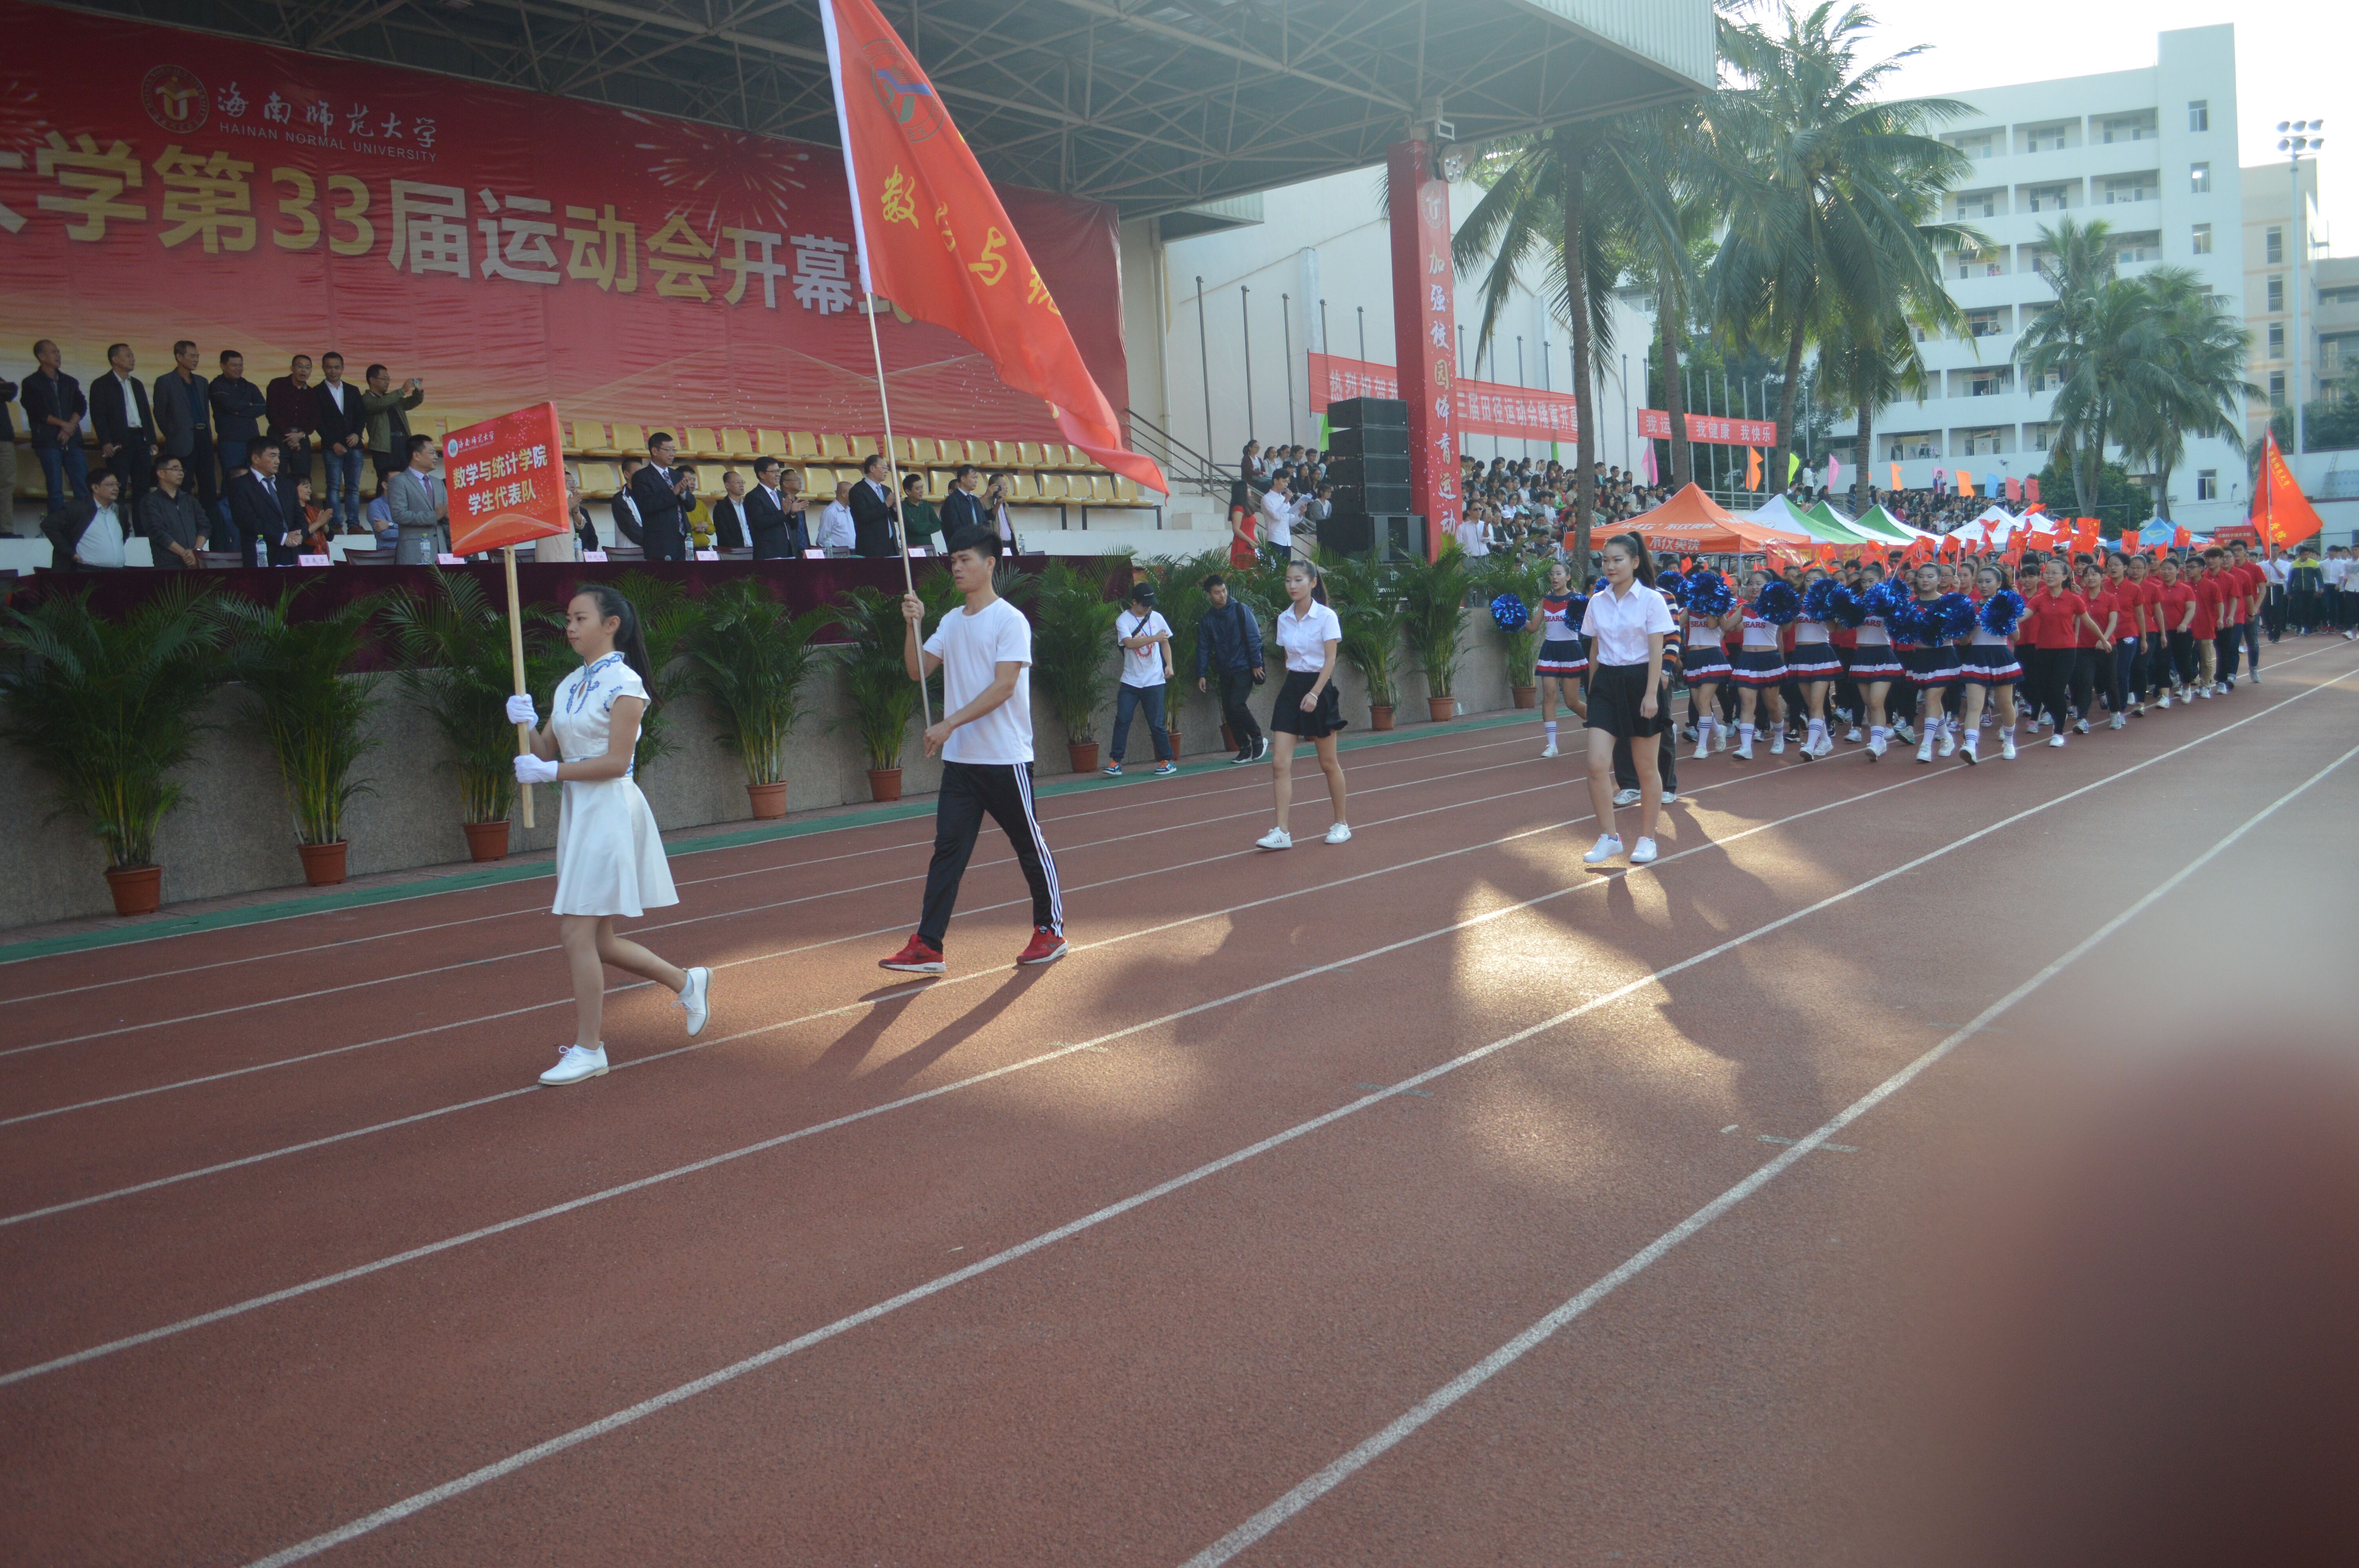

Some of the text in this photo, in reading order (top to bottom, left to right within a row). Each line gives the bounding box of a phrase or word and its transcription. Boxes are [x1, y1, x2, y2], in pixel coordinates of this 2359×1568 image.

[218, 81, 436, 148] 海南师范大学
[220, 122, 437, 162] HAINAN NORMAL UNIVERSITY
[0, 131, 912, 323] 学第33届运动会开幕
[1646, 415, 1770, 442] 我运 我健康 我快乐
[453, 444, 547, 490] 数学与统计学院
[469, 479, 536, 516] 学生代表队
[1649, 536, 1700, 551] 不仅更快
